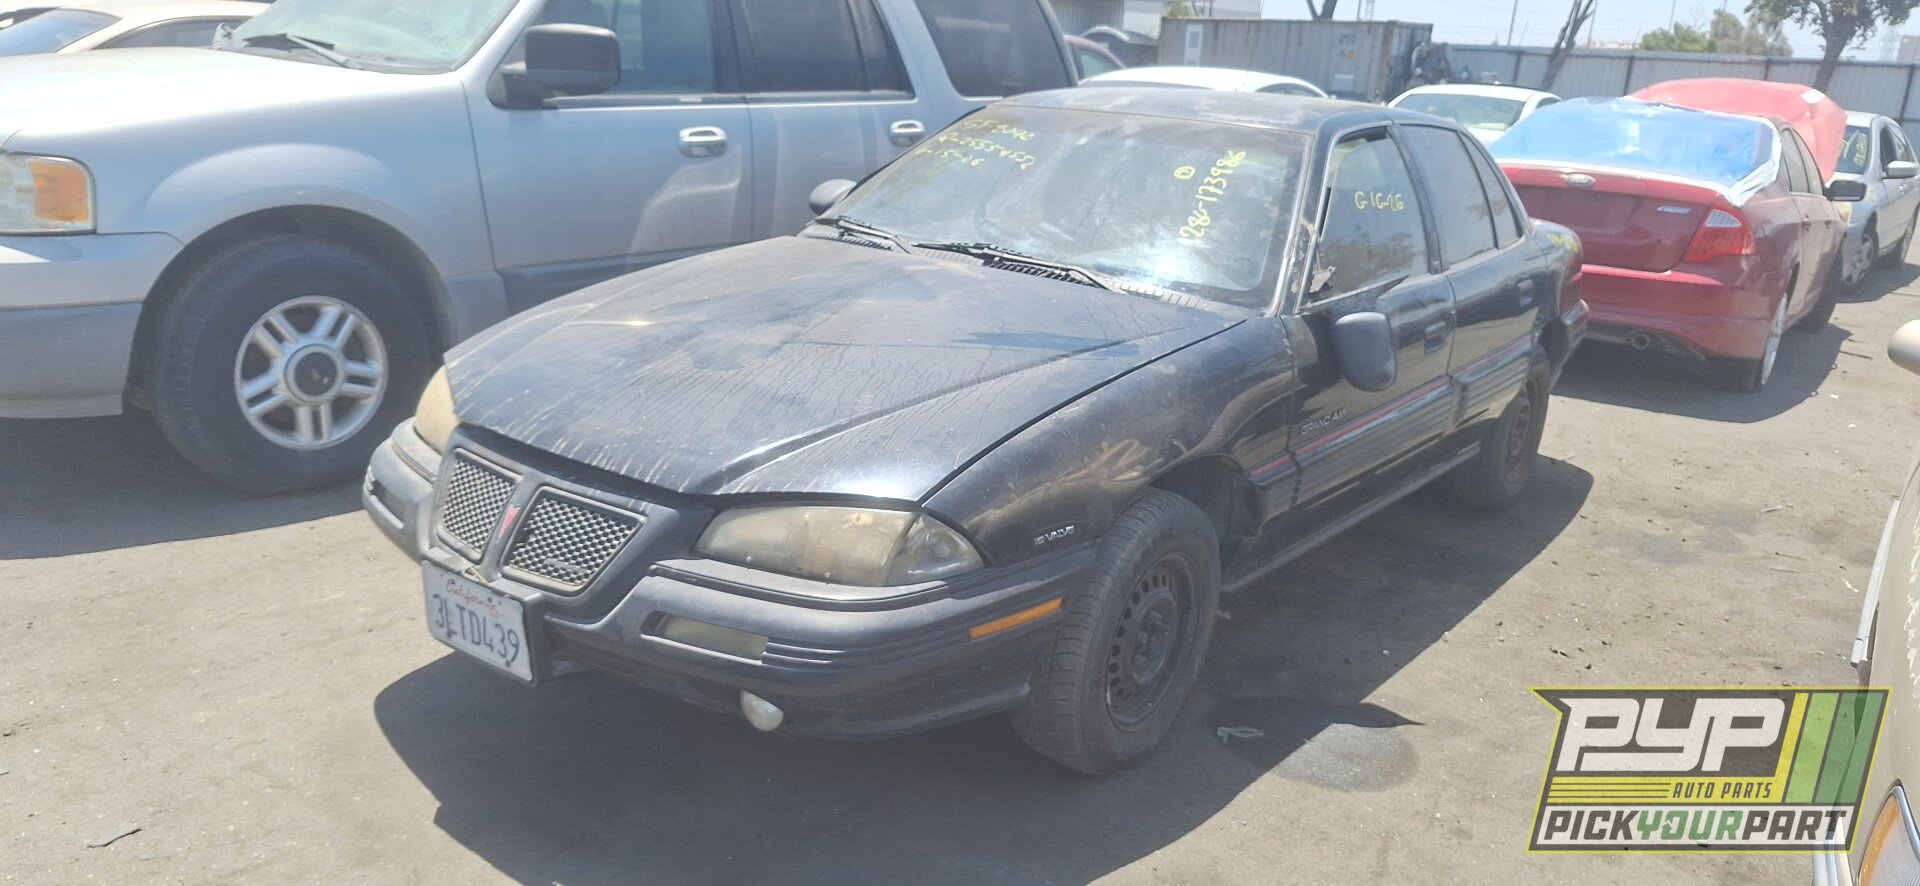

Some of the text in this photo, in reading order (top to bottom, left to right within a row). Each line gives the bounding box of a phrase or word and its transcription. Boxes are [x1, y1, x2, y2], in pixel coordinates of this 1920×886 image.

[1301, 416, 1331, 435] GRAND
[1044, 524, 1075, 541] VALVE
[432, 592, 520, 663] 3LTD439
